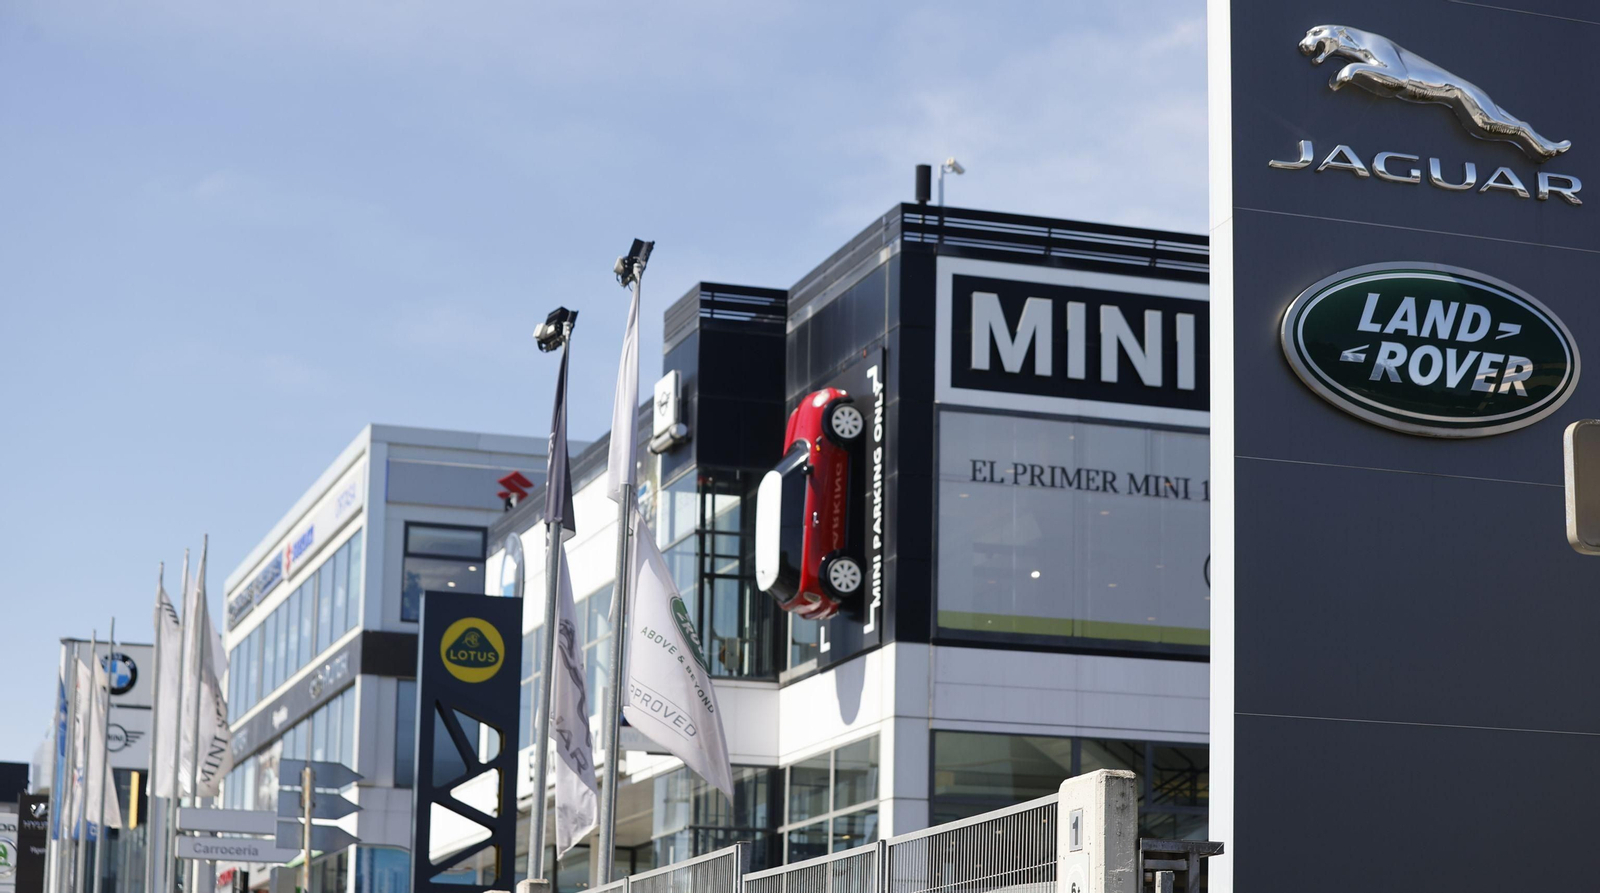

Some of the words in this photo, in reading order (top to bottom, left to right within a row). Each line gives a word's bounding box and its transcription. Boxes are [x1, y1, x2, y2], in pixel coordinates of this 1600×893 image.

[1269, 139, 1582, 206] JAGUAR
[971, 291, 1196, 391] MINI
[1357, 292, 1492, 343] LAND
[1369, 341, 1534, 397] ROVER
[873, 380, 884, 442] ONLY
[872, 446, 883, 549] PARKING
[970, 459, 1005, 485] EL
[1012, 462, 1119, 494] PRIMER
[1126, 472, 1192, 501] MINI
[871, 554, 882, 608] MINI
[450, 649, 496, 662] LOTUS
[641, 626, 678, 655] ABOVE
[677, 655, 685, 664] &
[685, 665, 715, 714] BEYOND
[1072, 815, 1079, 846] 1
